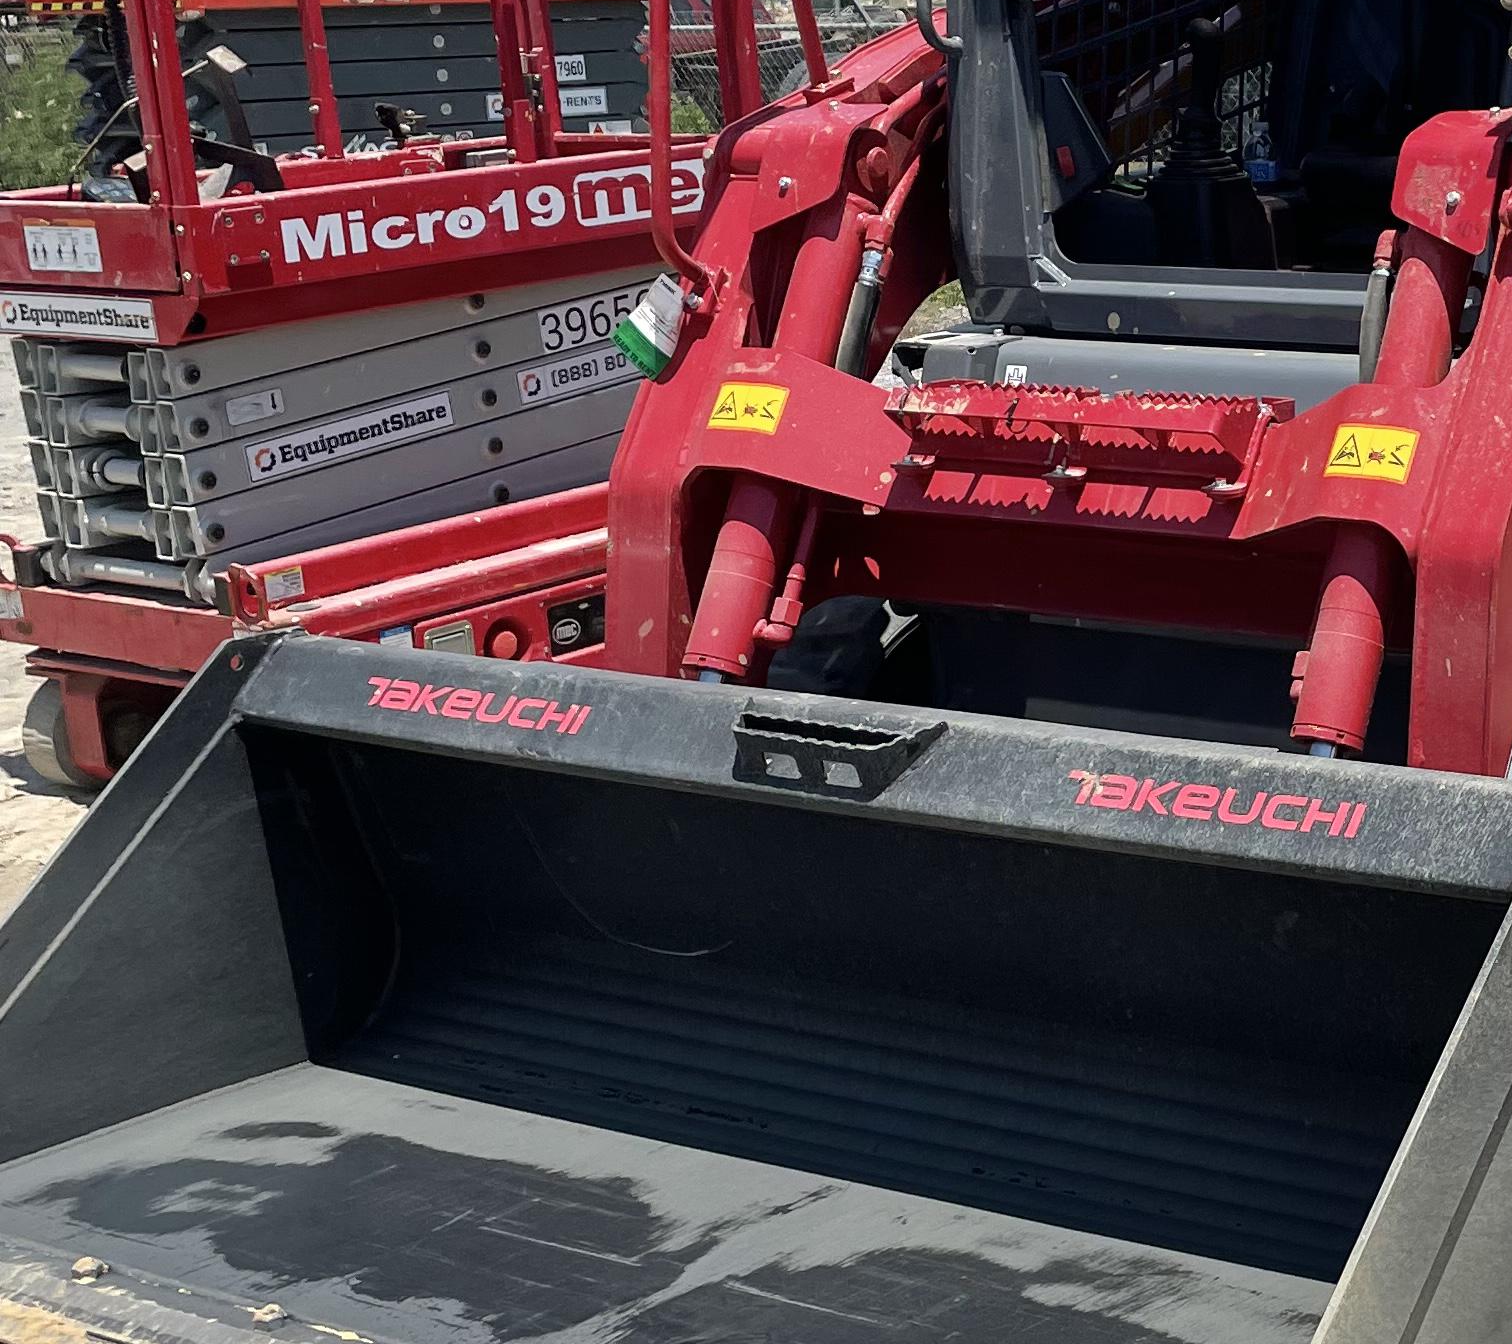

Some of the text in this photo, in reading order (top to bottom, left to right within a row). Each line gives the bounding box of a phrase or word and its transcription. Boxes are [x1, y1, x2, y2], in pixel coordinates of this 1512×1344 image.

[279, 183, 567, 264] Micro19
[18, 303, 151, 330] EquipmentShare
[278, 405, 448, 463] EquipmentShare
